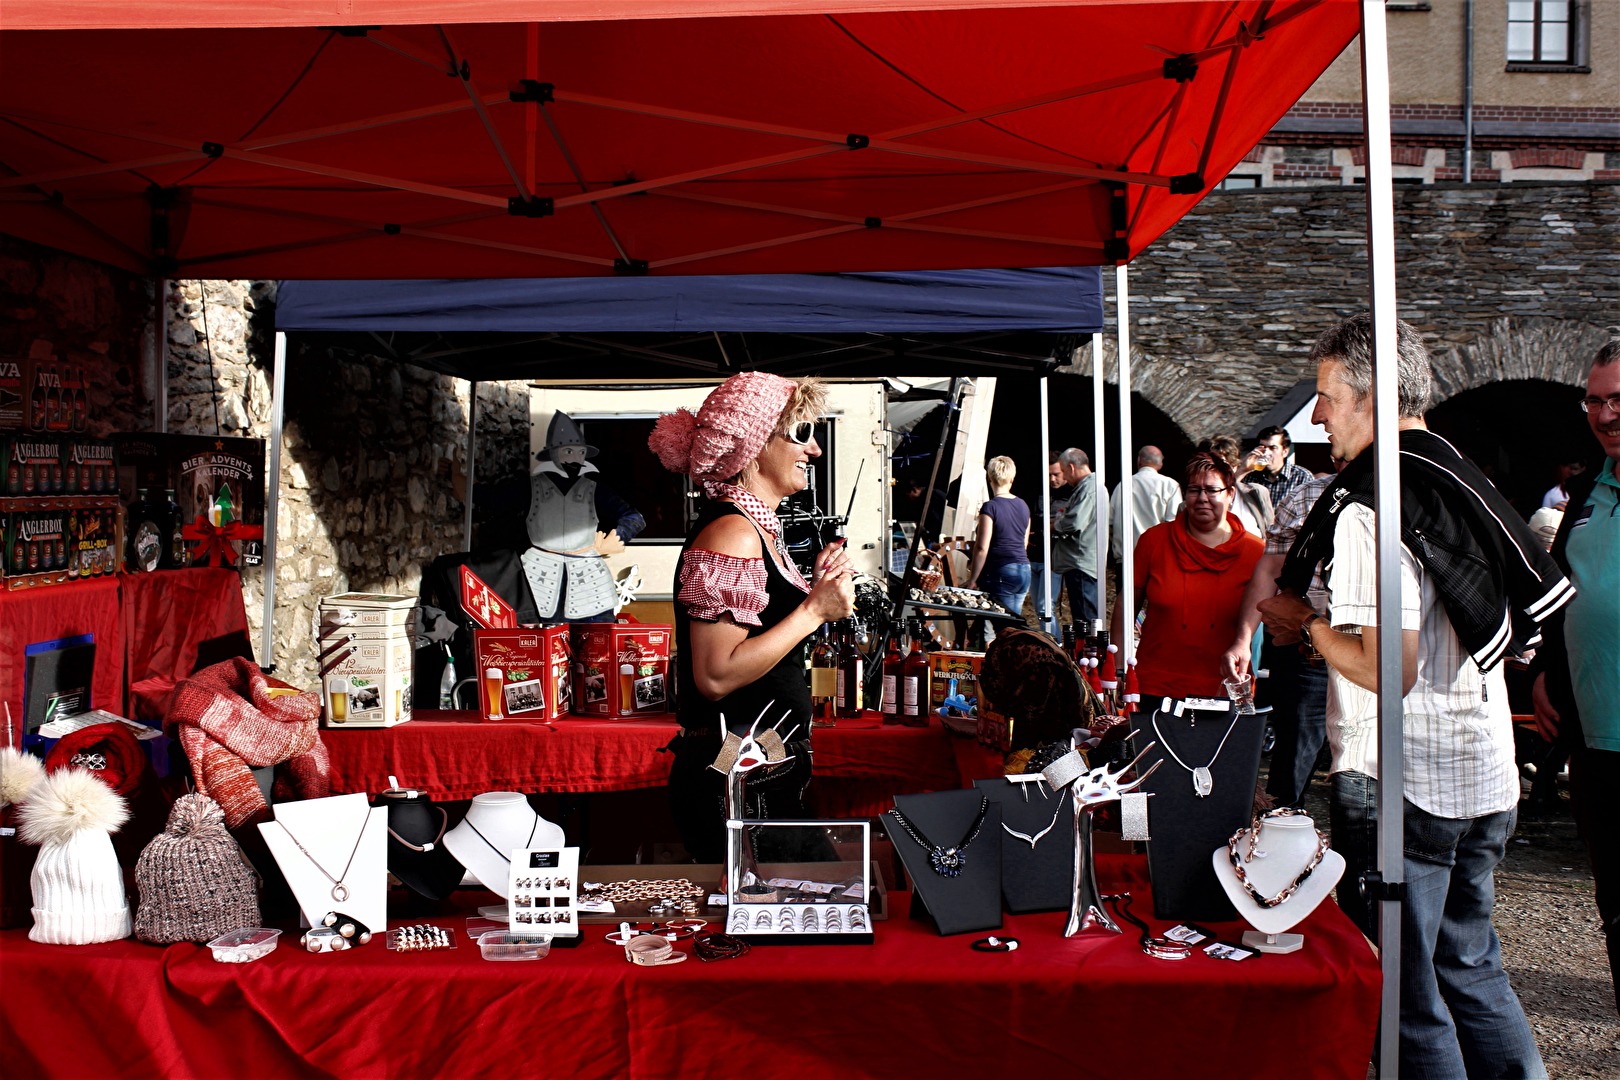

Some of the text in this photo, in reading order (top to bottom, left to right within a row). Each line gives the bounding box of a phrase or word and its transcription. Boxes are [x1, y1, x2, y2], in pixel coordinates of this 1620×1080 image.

[38, 373, 61, 388] NVA
[12, 441, 60, 464] ANGLERBOX
[69, 442, 114, 465] ANGLERBOX
[182, 455, 253, 473] BIER ADVENTS
[195, 468, 240, 480] KALENDER
[18, 518, 63, 541] ANGLERBOX
[79, 539, 108, 550] GRILL-BOX
[341, 659, 356, 669] 12
